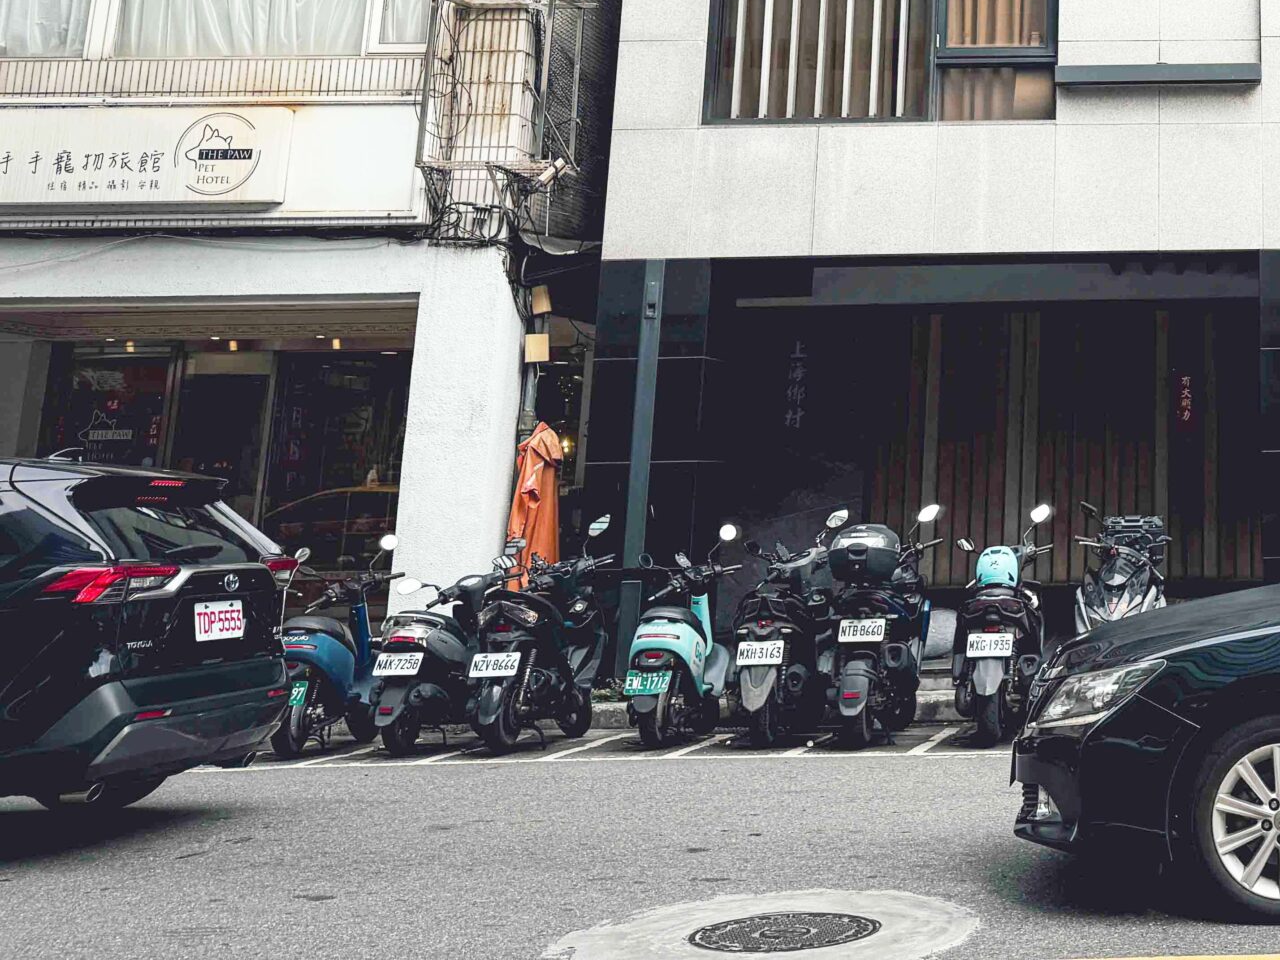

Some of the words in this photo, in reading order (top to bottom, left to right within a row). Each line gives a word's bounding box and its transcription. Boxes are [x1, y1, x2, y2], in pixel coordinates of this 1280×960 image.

[200, 150, 224, 159] THE
[227, 150, 251, 159] PAW
[198, 163, 216, 172] PET
[196, 175, 232, 185] HOTEL
[785, 340, 808, 428] 上海鄉村
[196, 609, 242, 635] TDP-5553
[840, 624, 883, 637] NTB-8660
[968, 640, 1011, 652] MXG-1935
[738, 646, 781, 660] MXH-3163
[375, 657, 420, 671] NAK-7258
[472, 658, 517, 672] NZV-8666
